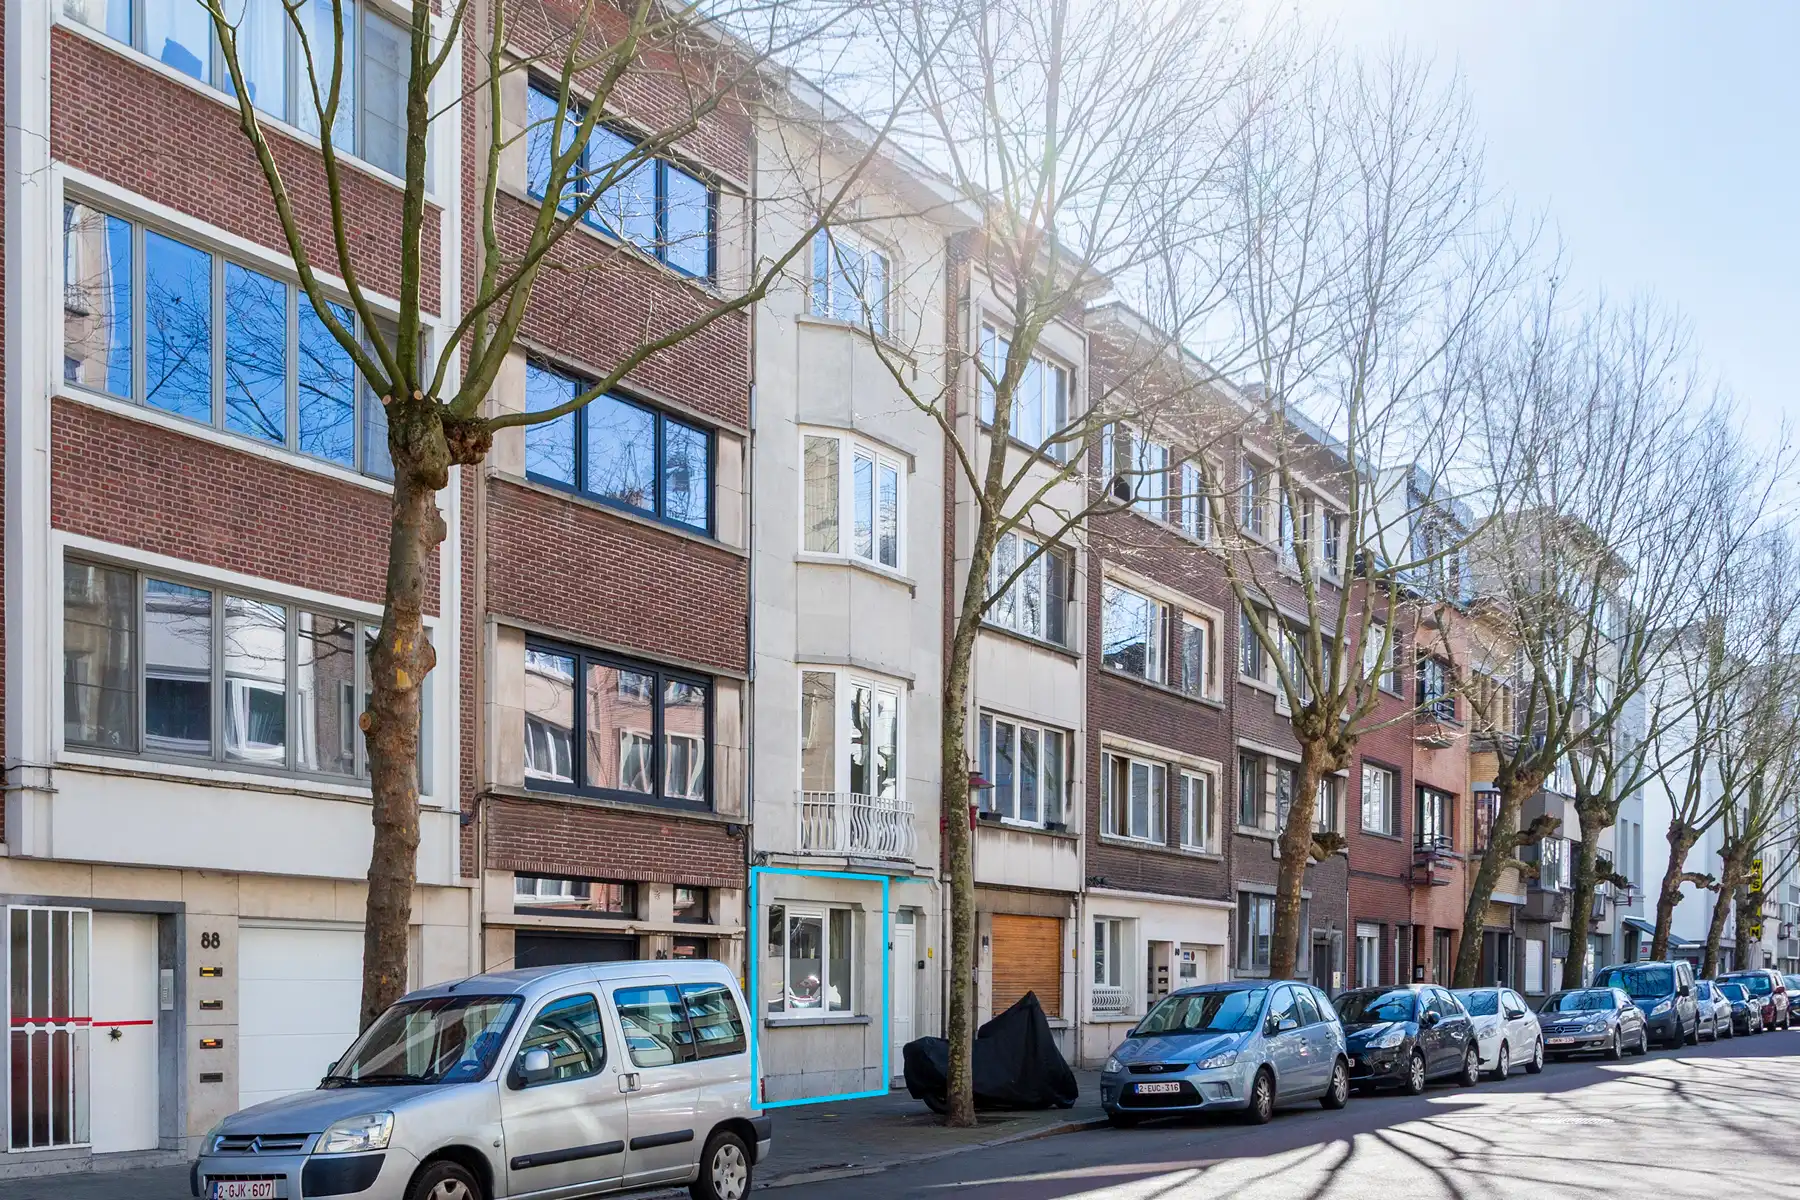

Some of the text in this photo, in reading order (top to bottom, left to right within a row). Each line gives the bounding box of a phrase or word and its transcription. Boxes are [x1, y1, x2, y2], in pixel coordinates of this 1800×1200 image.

[201, 932, 220, 949] 88
[1139, 1083, 1179, 1093] 2-EUC-316
[218, 1182, 271, 1199] 2-GJK-607
